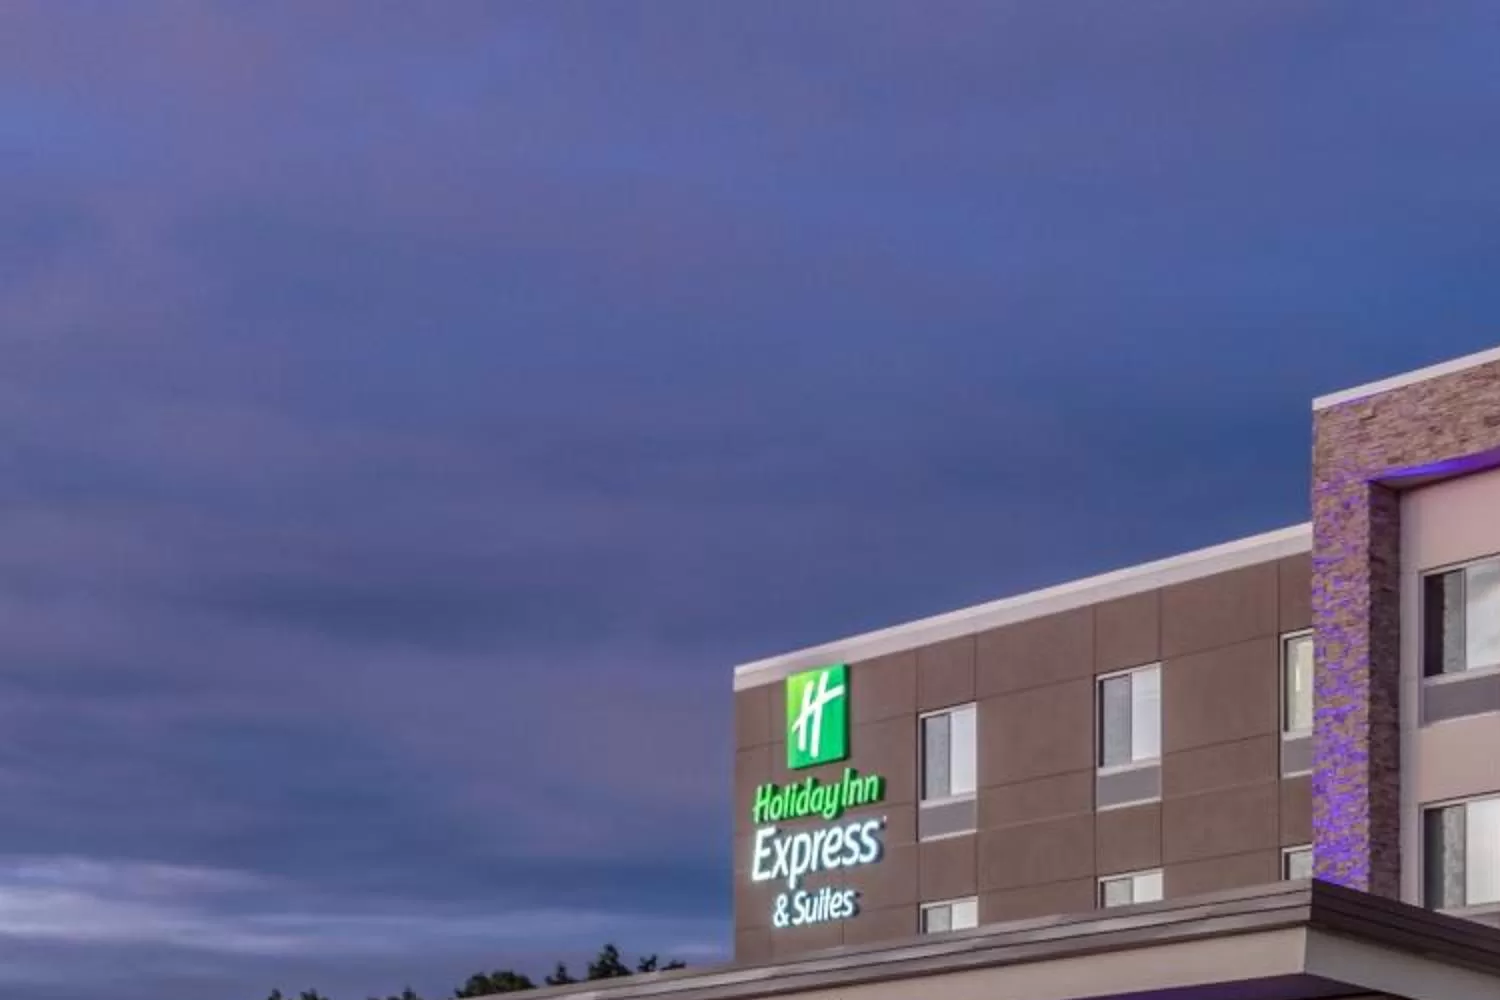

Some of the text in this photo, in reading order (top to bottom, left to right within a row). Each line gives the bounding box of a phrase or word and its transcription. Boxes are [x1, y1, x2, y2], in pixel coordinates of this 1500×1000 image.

[792, 671, 845, 758] H
[753, 767, 880, 823] Holiday Inn
[752, 819, 880, 890] Express
[773, 886, 855, 928] & Suites
